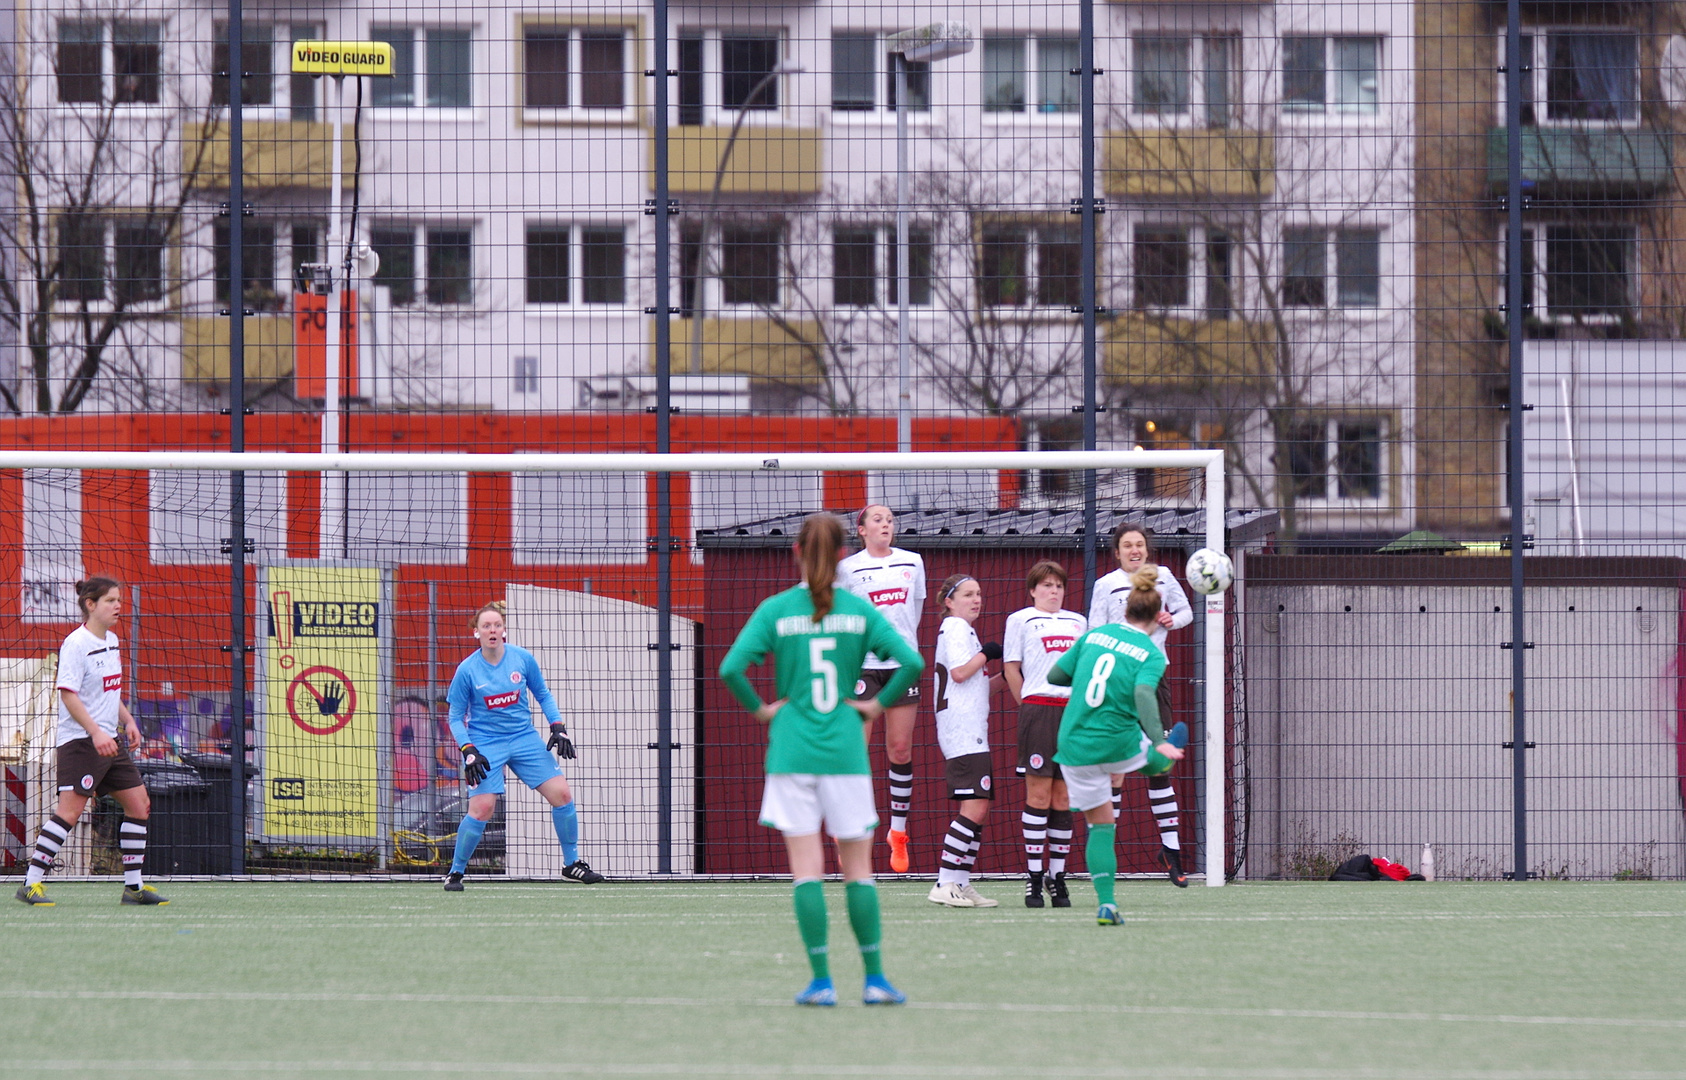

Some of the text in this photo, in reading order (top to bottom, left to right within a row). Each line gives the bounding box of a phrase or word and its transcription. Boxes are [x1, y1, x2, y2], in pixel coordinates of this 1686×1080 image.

[343, 52, 385, 65] GUARD
[298, 603, 376, 625] VIDEO
[299, 624, 375, 636] ÜBERWACHUNG
[809, 637, 838, 714] 5
[1085, 653, 1116, 708] 8
[273, 781, 303, 797] ISG
[307, 782, 364, 790] INTERNATIONAL
[307, 790, 371, 798] SECURITY GROUP
